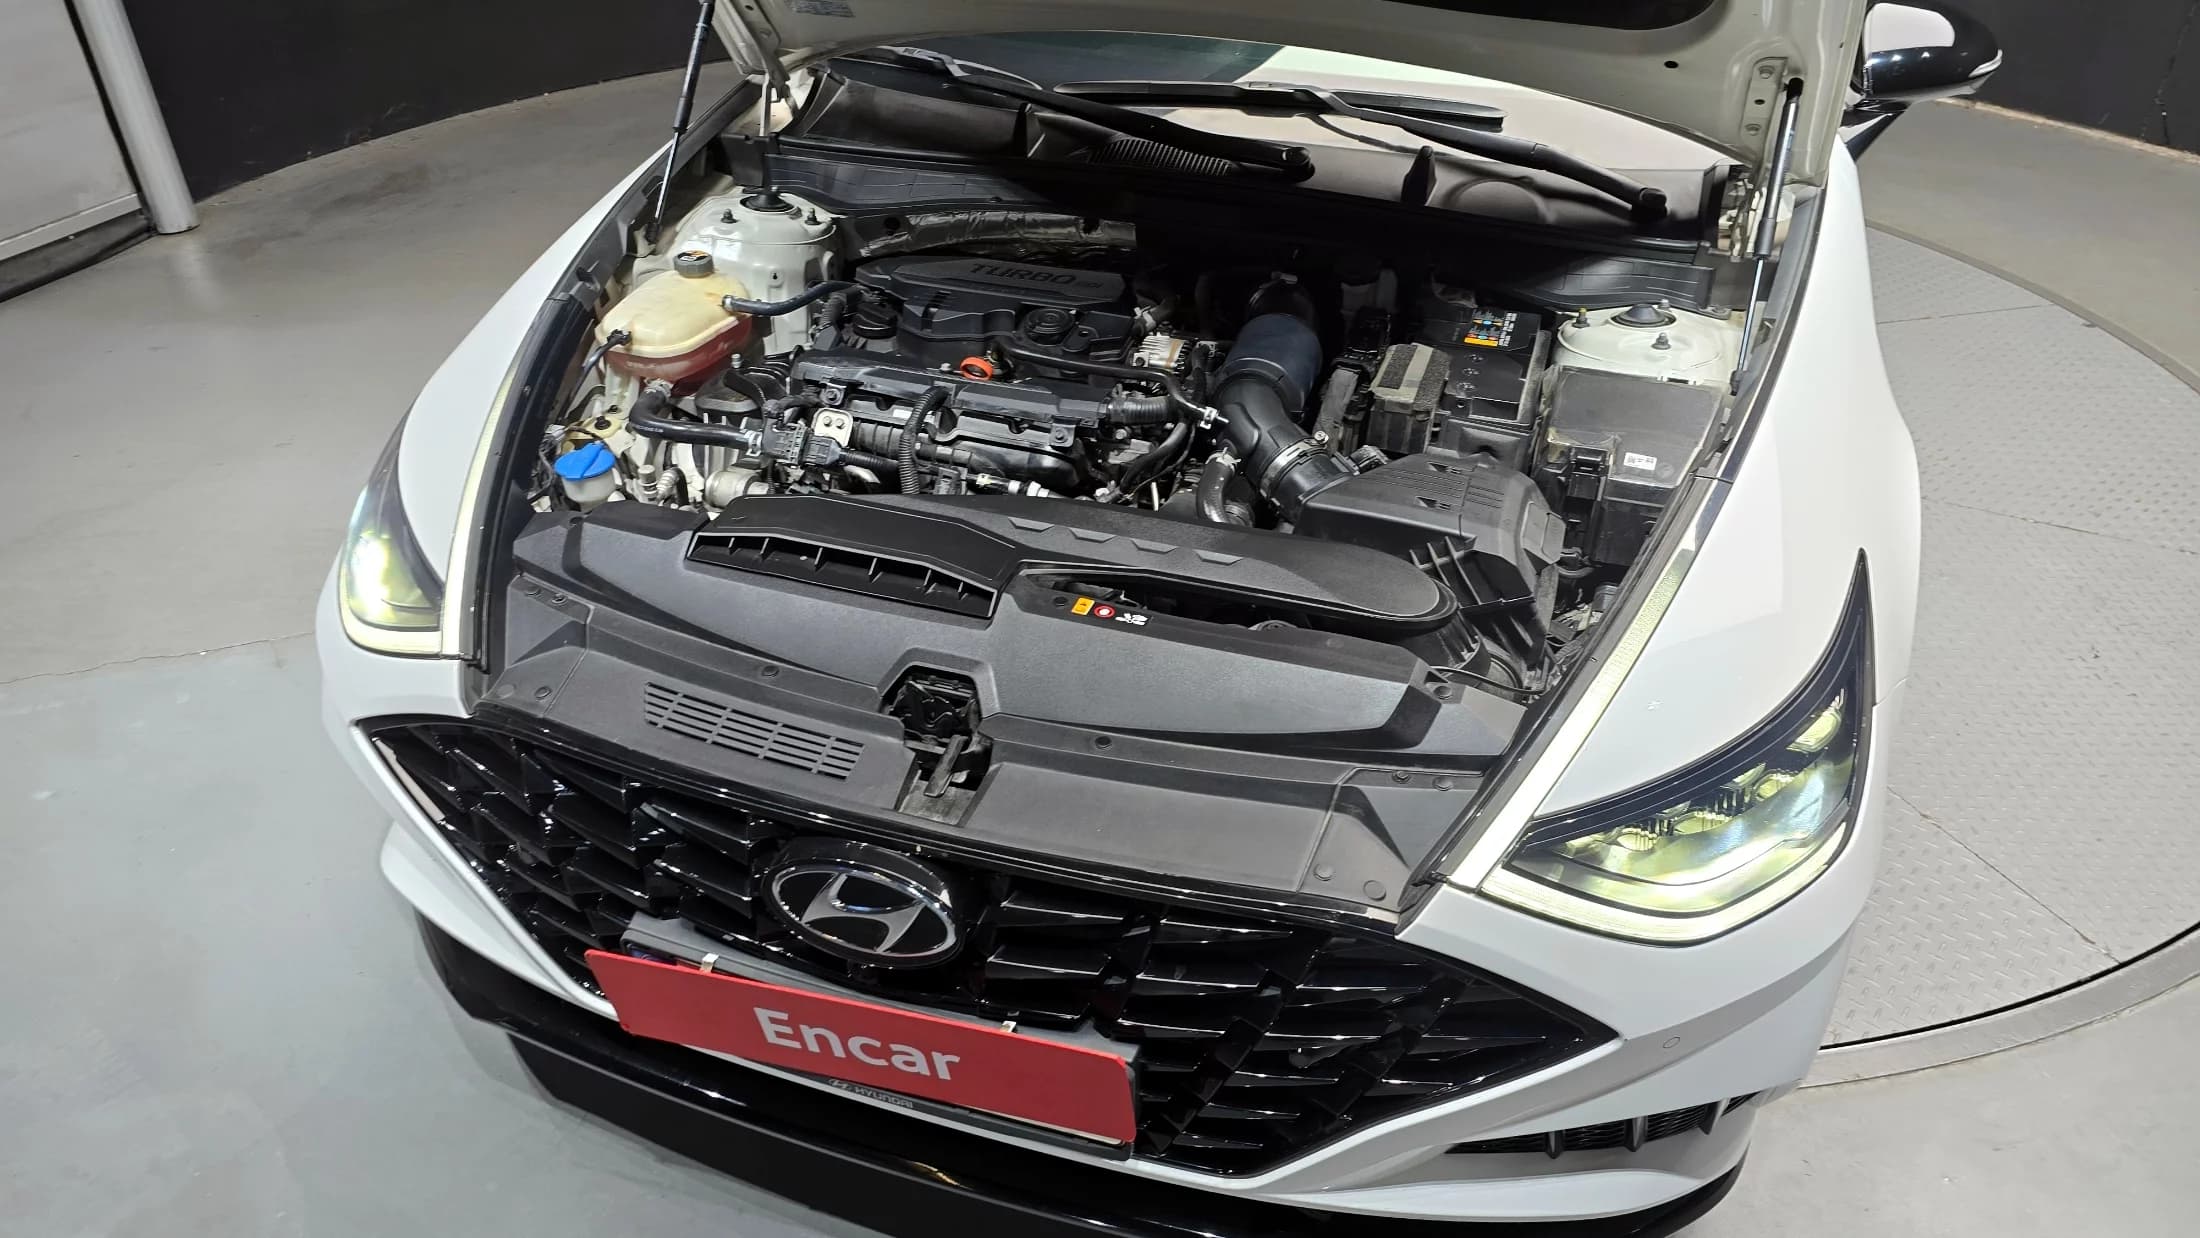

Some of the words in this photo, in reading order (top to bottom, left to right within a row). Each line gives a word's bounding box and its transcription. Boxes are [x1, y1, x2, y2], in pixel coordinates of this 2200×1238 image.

[970, 263, 1076, 284] TURBO
[753, 1007, 960, 1080] Encar
[855, 1086, 914, 1108] HYUNDAI
